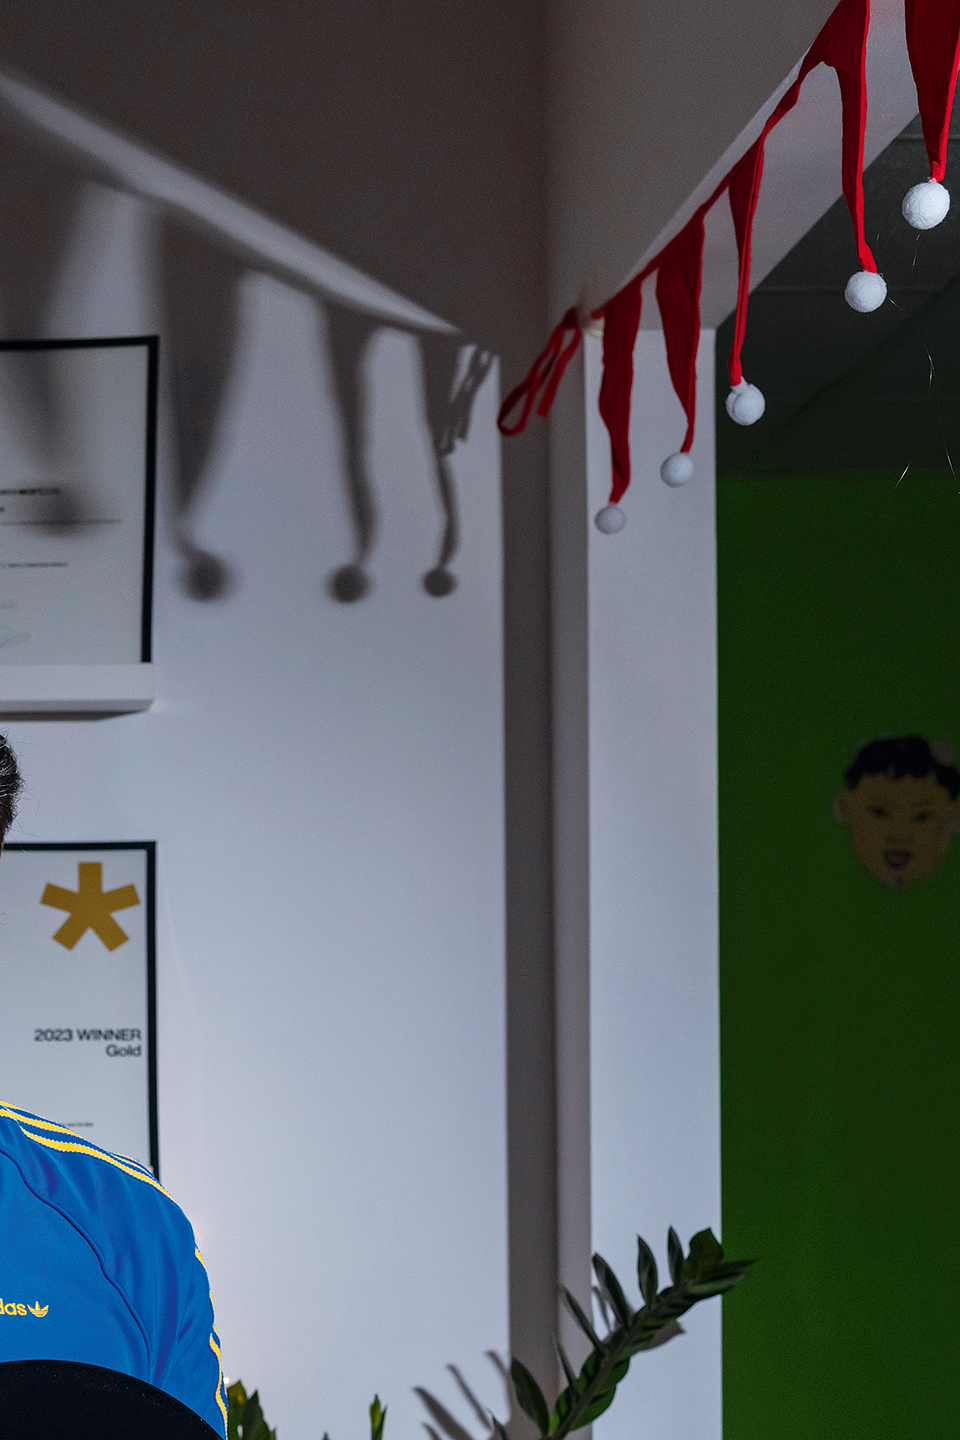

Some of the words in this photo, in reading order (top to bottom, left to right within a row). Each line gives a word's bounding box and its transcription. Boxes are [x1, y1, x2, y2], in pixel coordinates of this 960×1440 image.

[34, 1027, 73, 1042] 2023
[76, 1027, 142, 1042] WINNER
[105, 1043, 142, 1058] Gold
